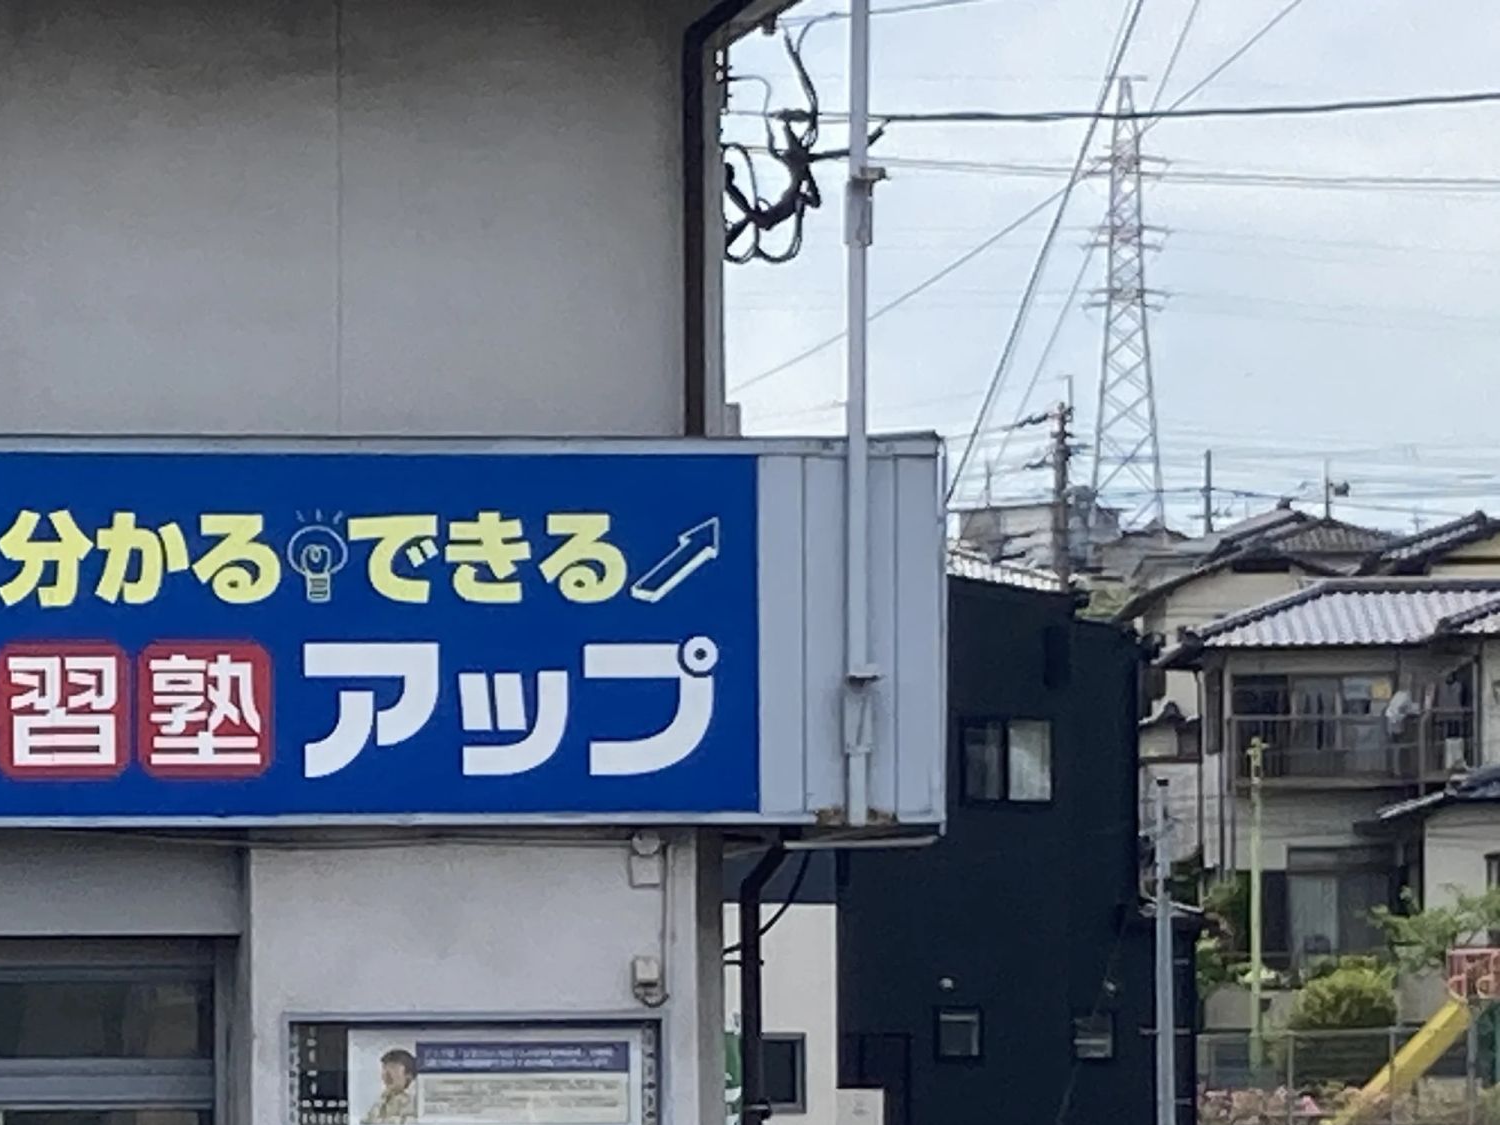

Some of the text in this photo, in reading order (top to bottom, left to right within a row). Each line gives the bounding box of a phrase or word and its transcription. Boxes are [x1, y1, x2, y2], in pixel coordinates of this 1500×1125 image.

[347, 510, 628, 604] できる
[303, 635, 719, 778] アップ
